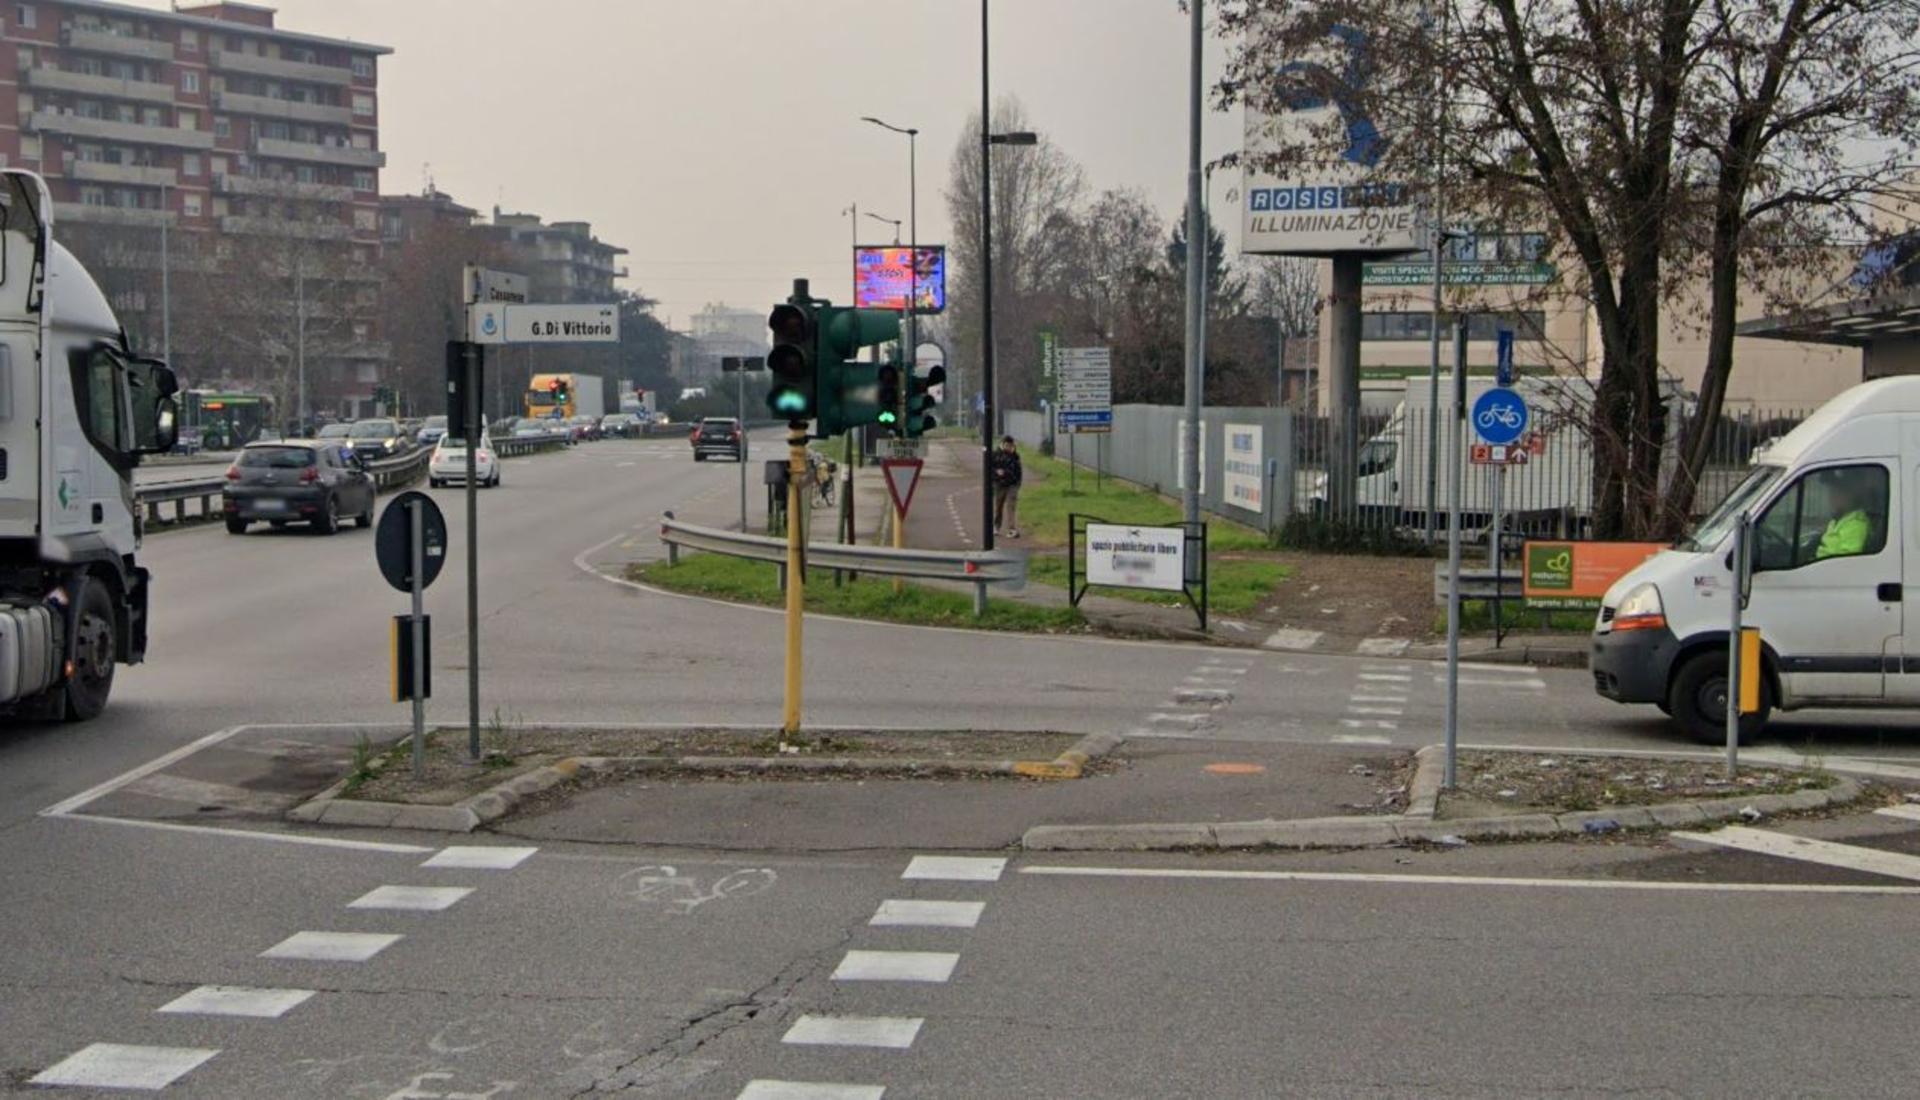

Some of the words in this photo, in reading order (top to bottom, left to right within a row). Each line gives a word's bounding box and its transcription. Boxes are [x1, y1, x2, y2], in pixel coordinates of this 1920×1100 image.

[1253, 183, 1405, 208] ROSS
[1251, 213, 1410, 233] ILLUMINAZIONE
[1371, 266, 1396, 275] VISITE
[563, 320, 612, 336] Vittorio
[1477, 448, 1486, 458] 2
[1091, 541, 1112, 552] spazio
[1113, 541, 1155, 553] pubblicitario
[1157, 542, 1177, 554] libero
